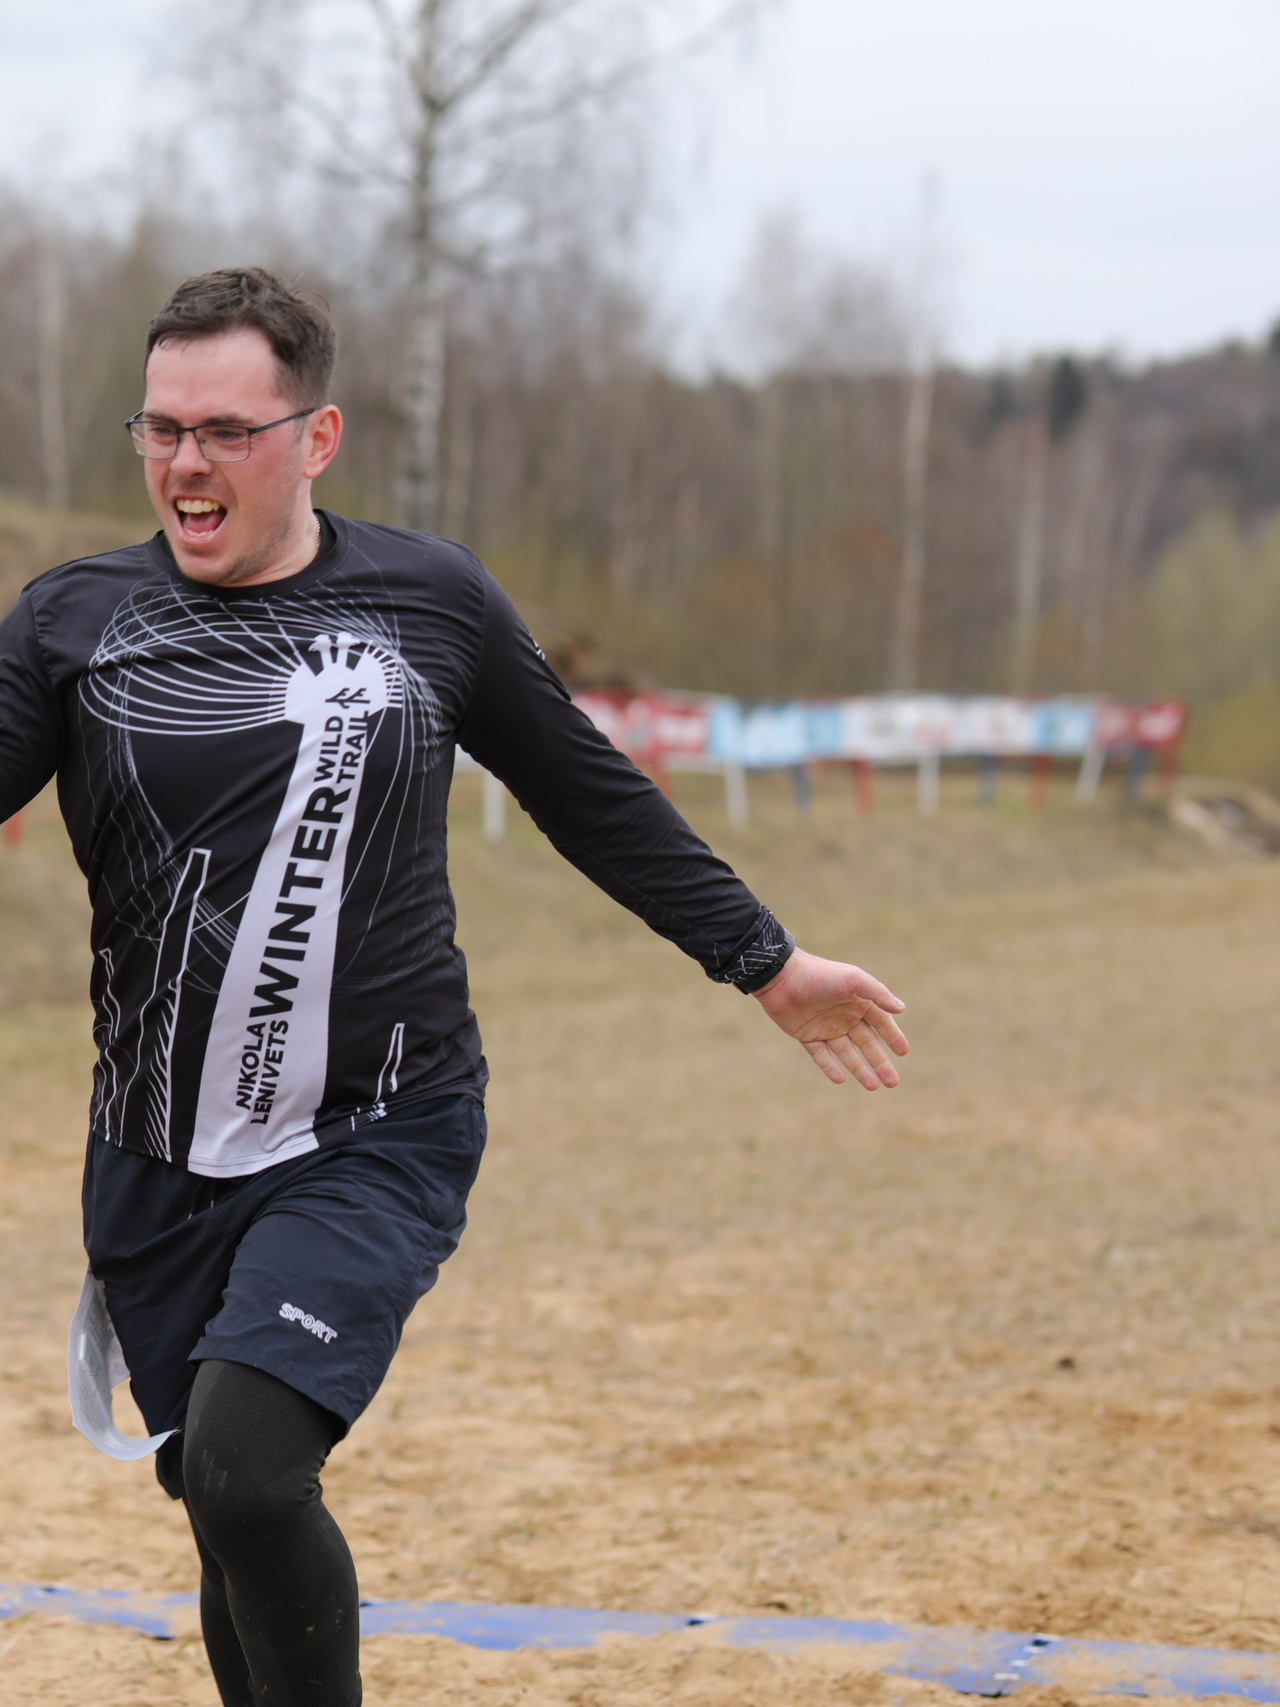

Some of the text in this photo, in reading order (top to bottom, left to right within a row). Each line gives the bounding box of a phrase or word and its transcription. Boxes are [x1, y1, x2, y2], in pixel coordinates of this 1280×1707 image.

[313, 715, 344, 783] WILD
[336, 710, 369, 784] TRAIL
[248, 786, 352, 1018] WINTER
[235, 1022, 266, 1110] NIKOLA
[250, 1020, 289, 1125] LENIVETS
[278, 1302, 338, 1344] SPORT
